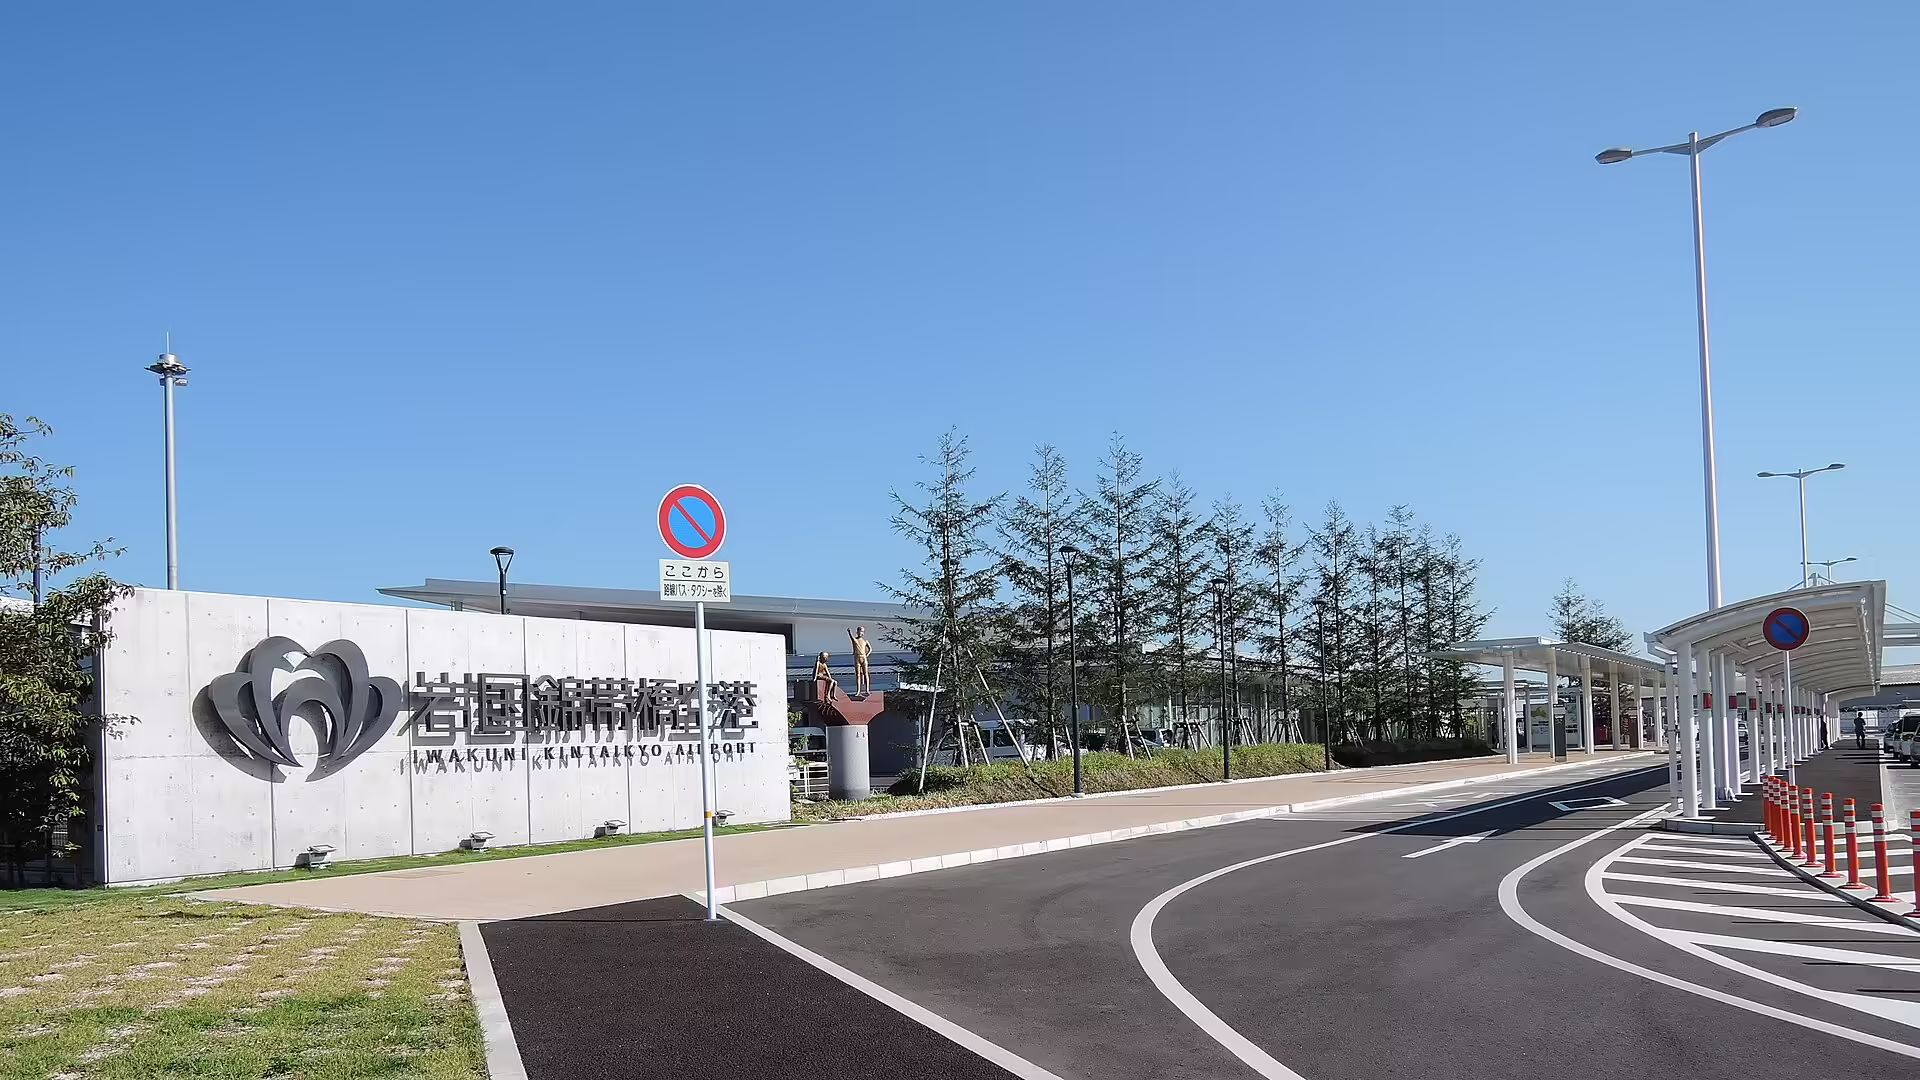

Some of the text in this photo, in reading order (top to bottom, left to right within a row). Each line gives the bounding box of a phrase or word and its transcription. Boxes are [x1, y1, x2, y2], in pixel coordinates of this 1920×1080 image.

[665, 565, 724, 579] ここから
[404, 672, 758, 734] 岩国錦帯橋空港
[413, 748, 526, 763] IWAKUNI
[544, 744, 662, 759] KINTAIKYO
